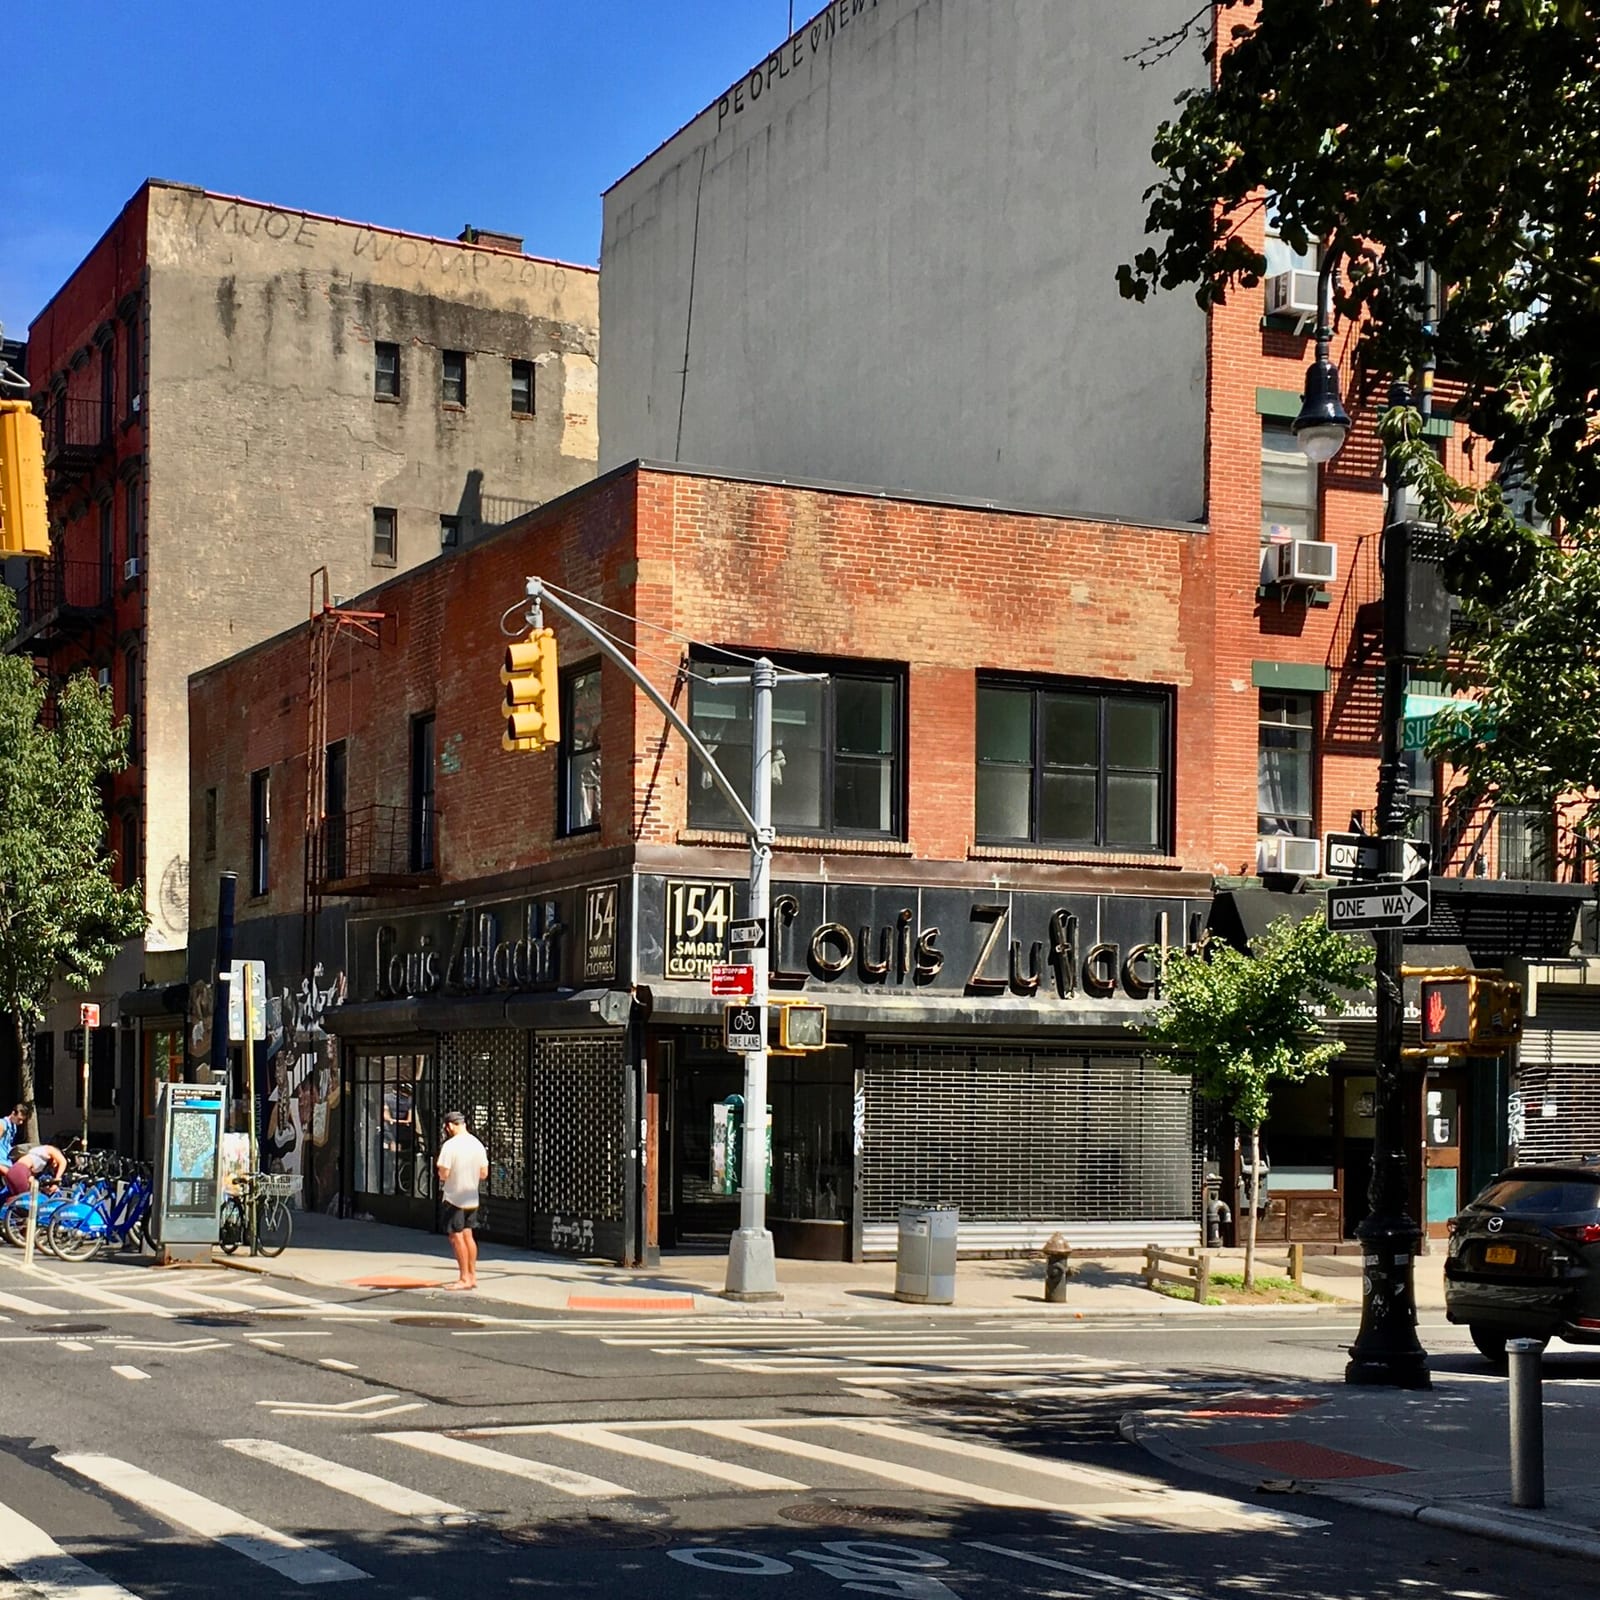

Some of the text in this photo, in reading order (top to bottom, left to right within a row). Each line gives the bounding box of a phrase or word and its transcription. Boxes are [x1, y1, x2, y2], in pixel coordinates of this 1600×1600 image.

[718, 36, 803, 133] PEOPLE
[673, 886, 728, 938] 154
[1336, 896, 1415, 917] ONE WAY
[588, 892, 615, 942] 154
[733, 929, 744, 941] ONE
[768, 893, 945, 990] Louis
[588, 944, 612, 960] SMART
[675, 940, 723, 957] SMART
[586, 960, 614, 975] CLOTHES
[1340, 1000, 1377, 1017] hoic
[730, 1035, 759, 1047] BIKE LANE
